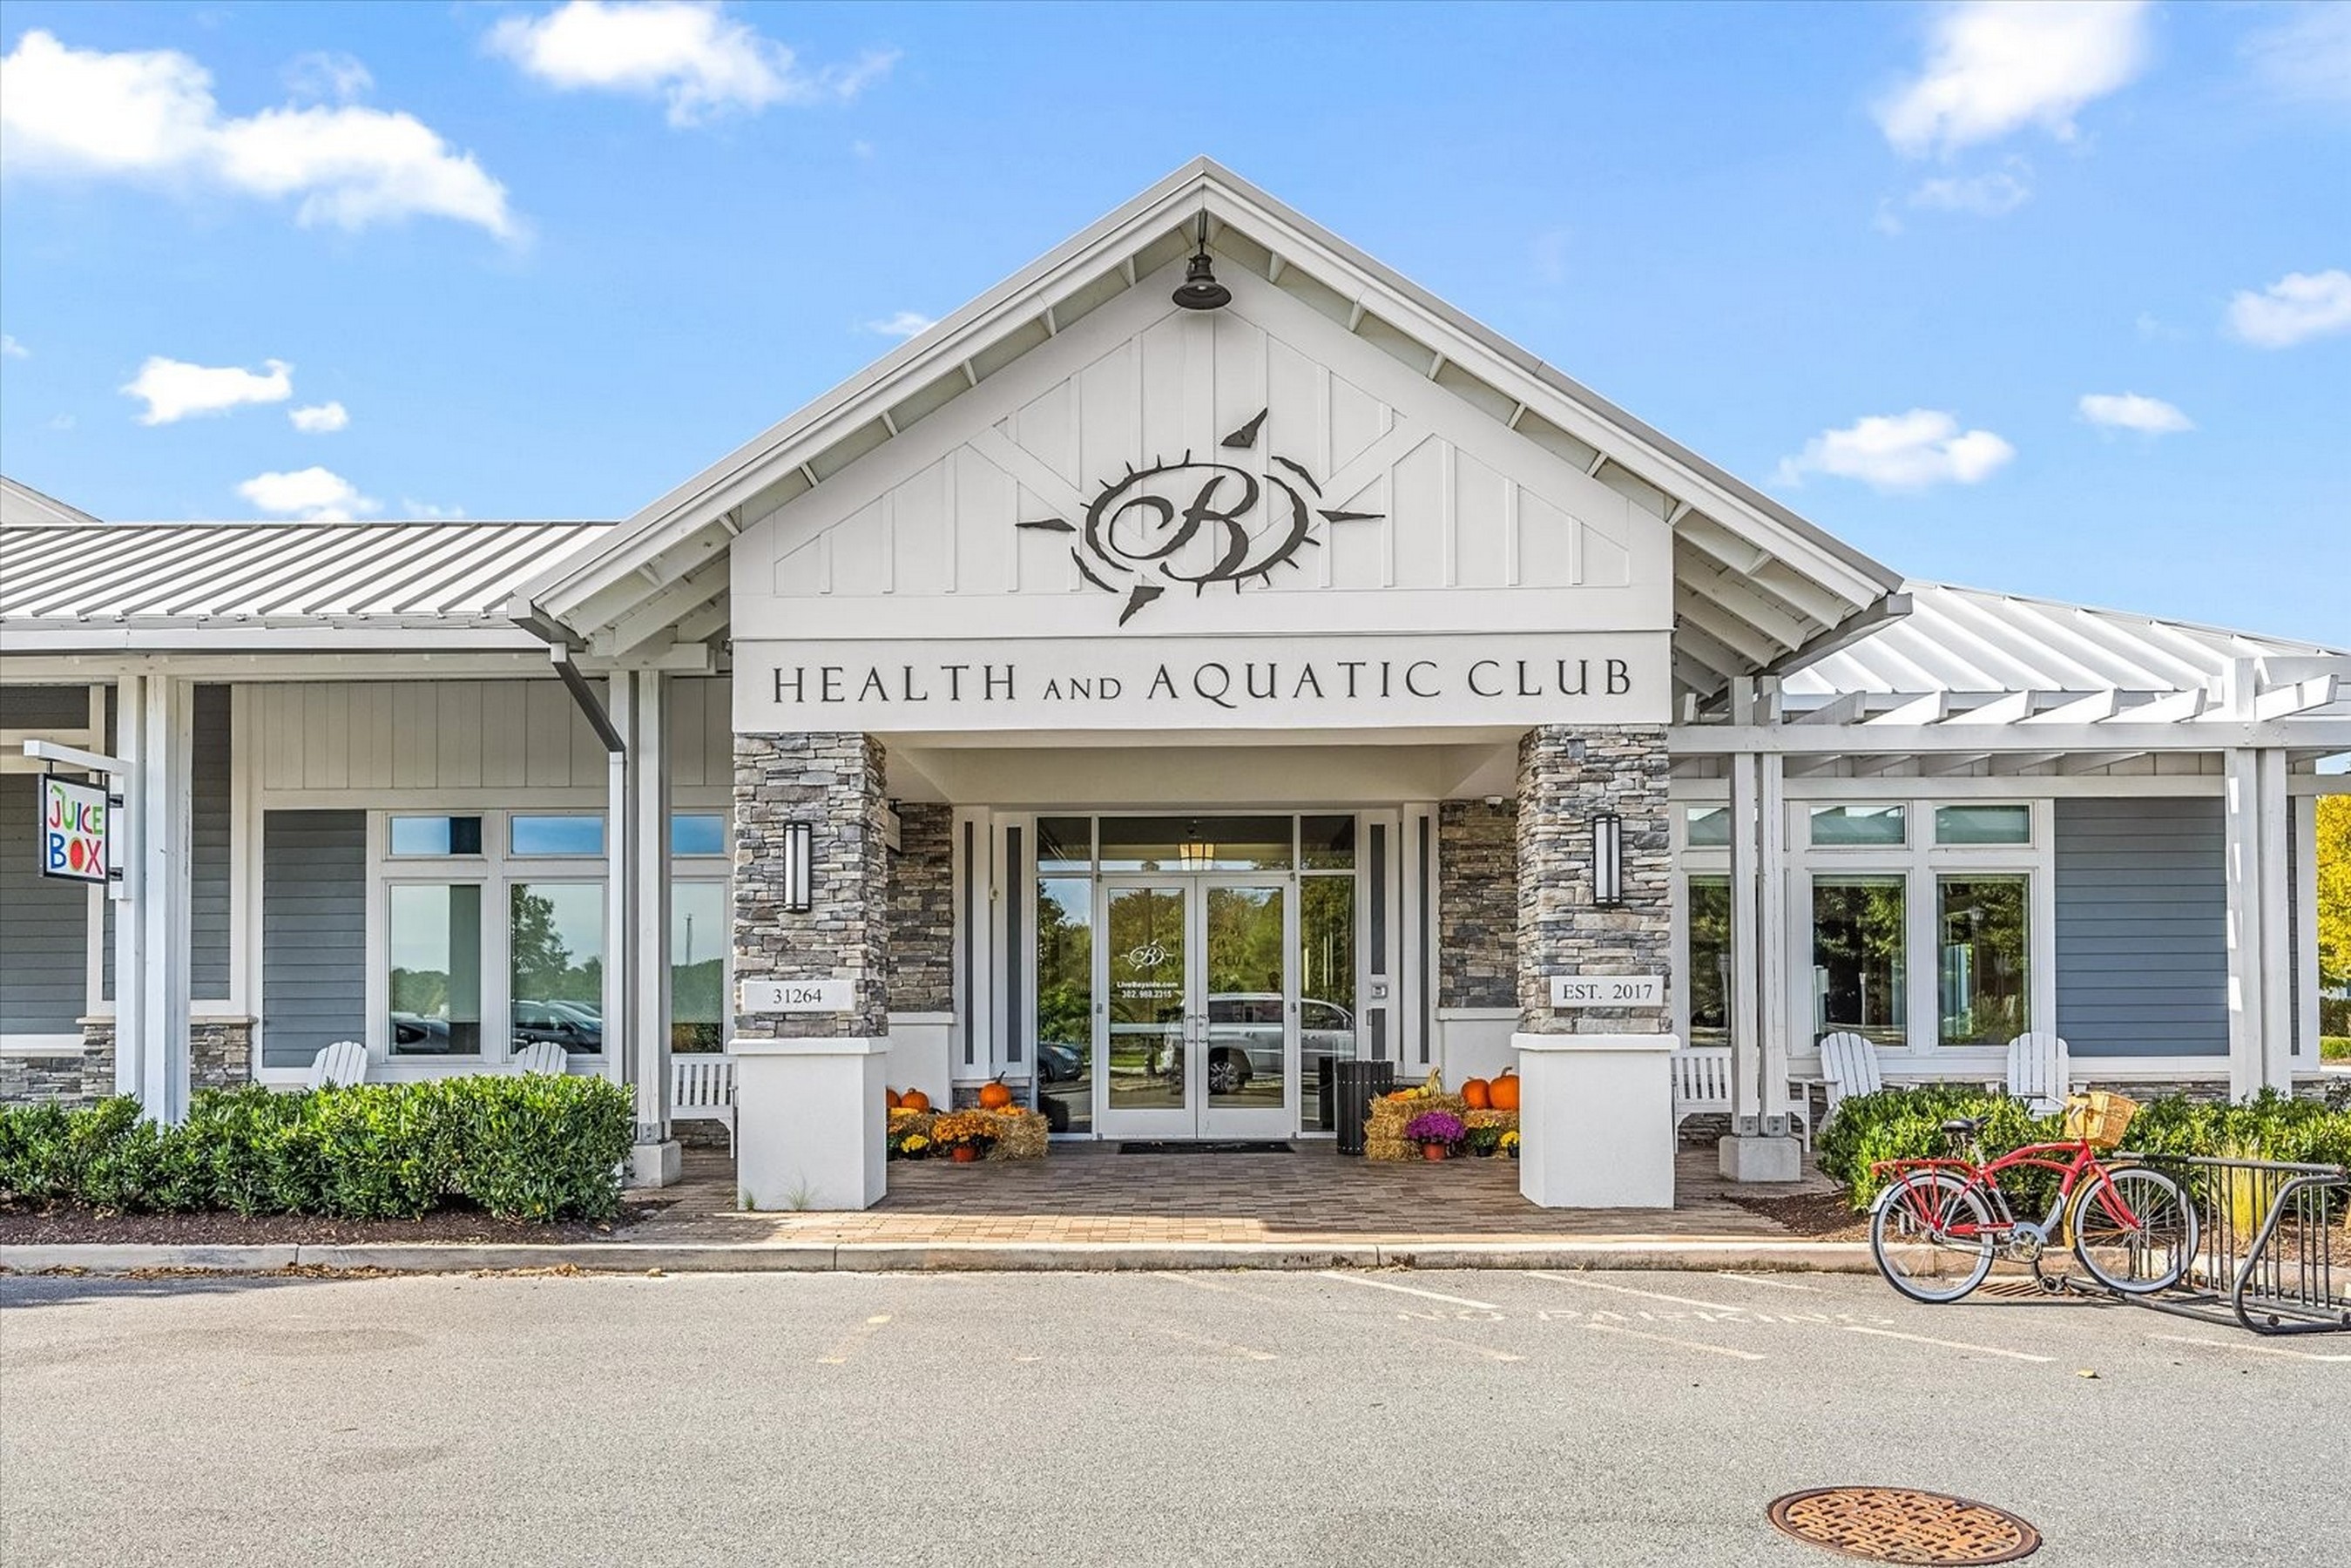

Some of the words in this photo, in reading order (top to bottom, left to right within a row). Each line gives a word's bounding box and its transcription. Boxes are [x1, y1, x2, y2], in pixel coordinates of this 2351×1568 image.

[773, 664, 1015, 703] HEALTH
[1043, 677, 1123, 700] AND
[1146, 659, 1441, 709] AQUATIC
[1467, 659, 1632, 697] CLUB
[49, 787, 104, 835] JUICE
[49, 832, 104, 875] BOX
[773, 988, 822, 1004] 31264
[1563, 983, 1603, 1000] EST.
[1612, 983, 1653, 999] 2017
